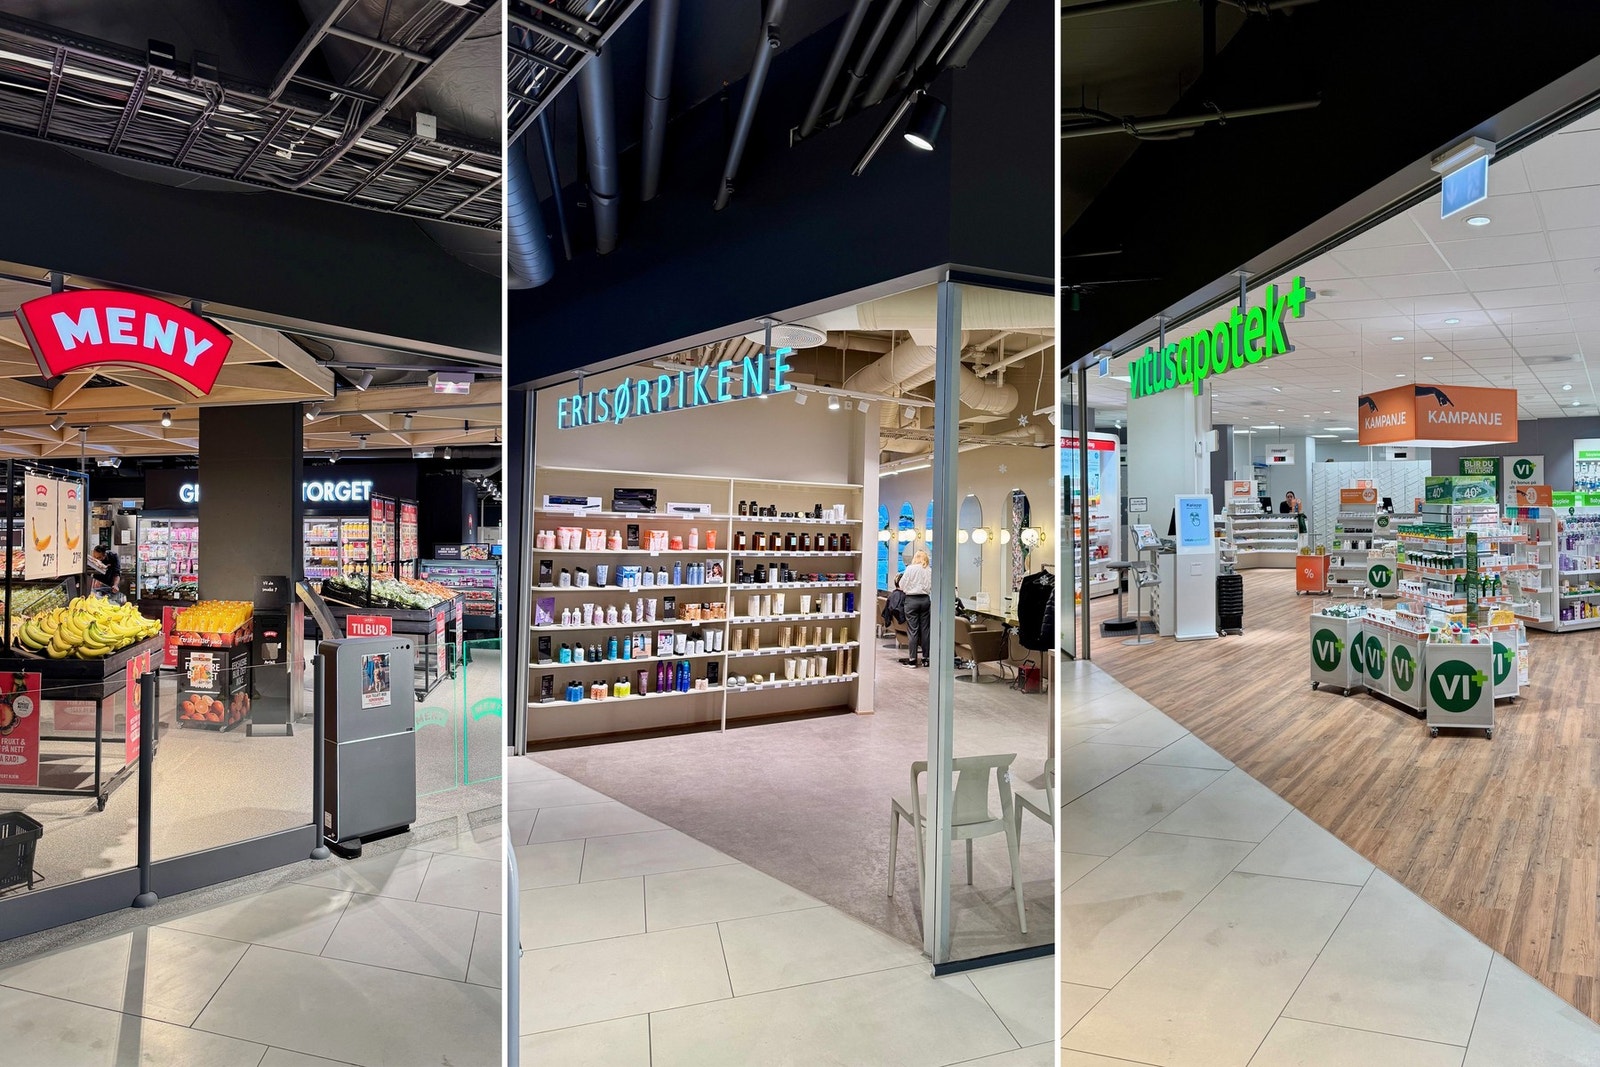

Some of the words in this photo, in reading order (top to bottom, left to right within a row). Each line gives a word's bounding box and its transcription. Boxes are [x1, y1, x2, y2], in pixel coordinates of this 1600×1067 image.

[51, 307, 213, 367] MENY
[557, 347, 792, 429] FRISØRPIKENE
[1365, 411, 1407, 430] KAMPANJE
[1428, 410, 1503, 426] KAMPANJE
[1464, 460, 1480, 468] BLIR
[1482, 460, 1494, 468] DU
[351, 623, 387, 635] TILBUD
[20, 738, 26, 746] &
